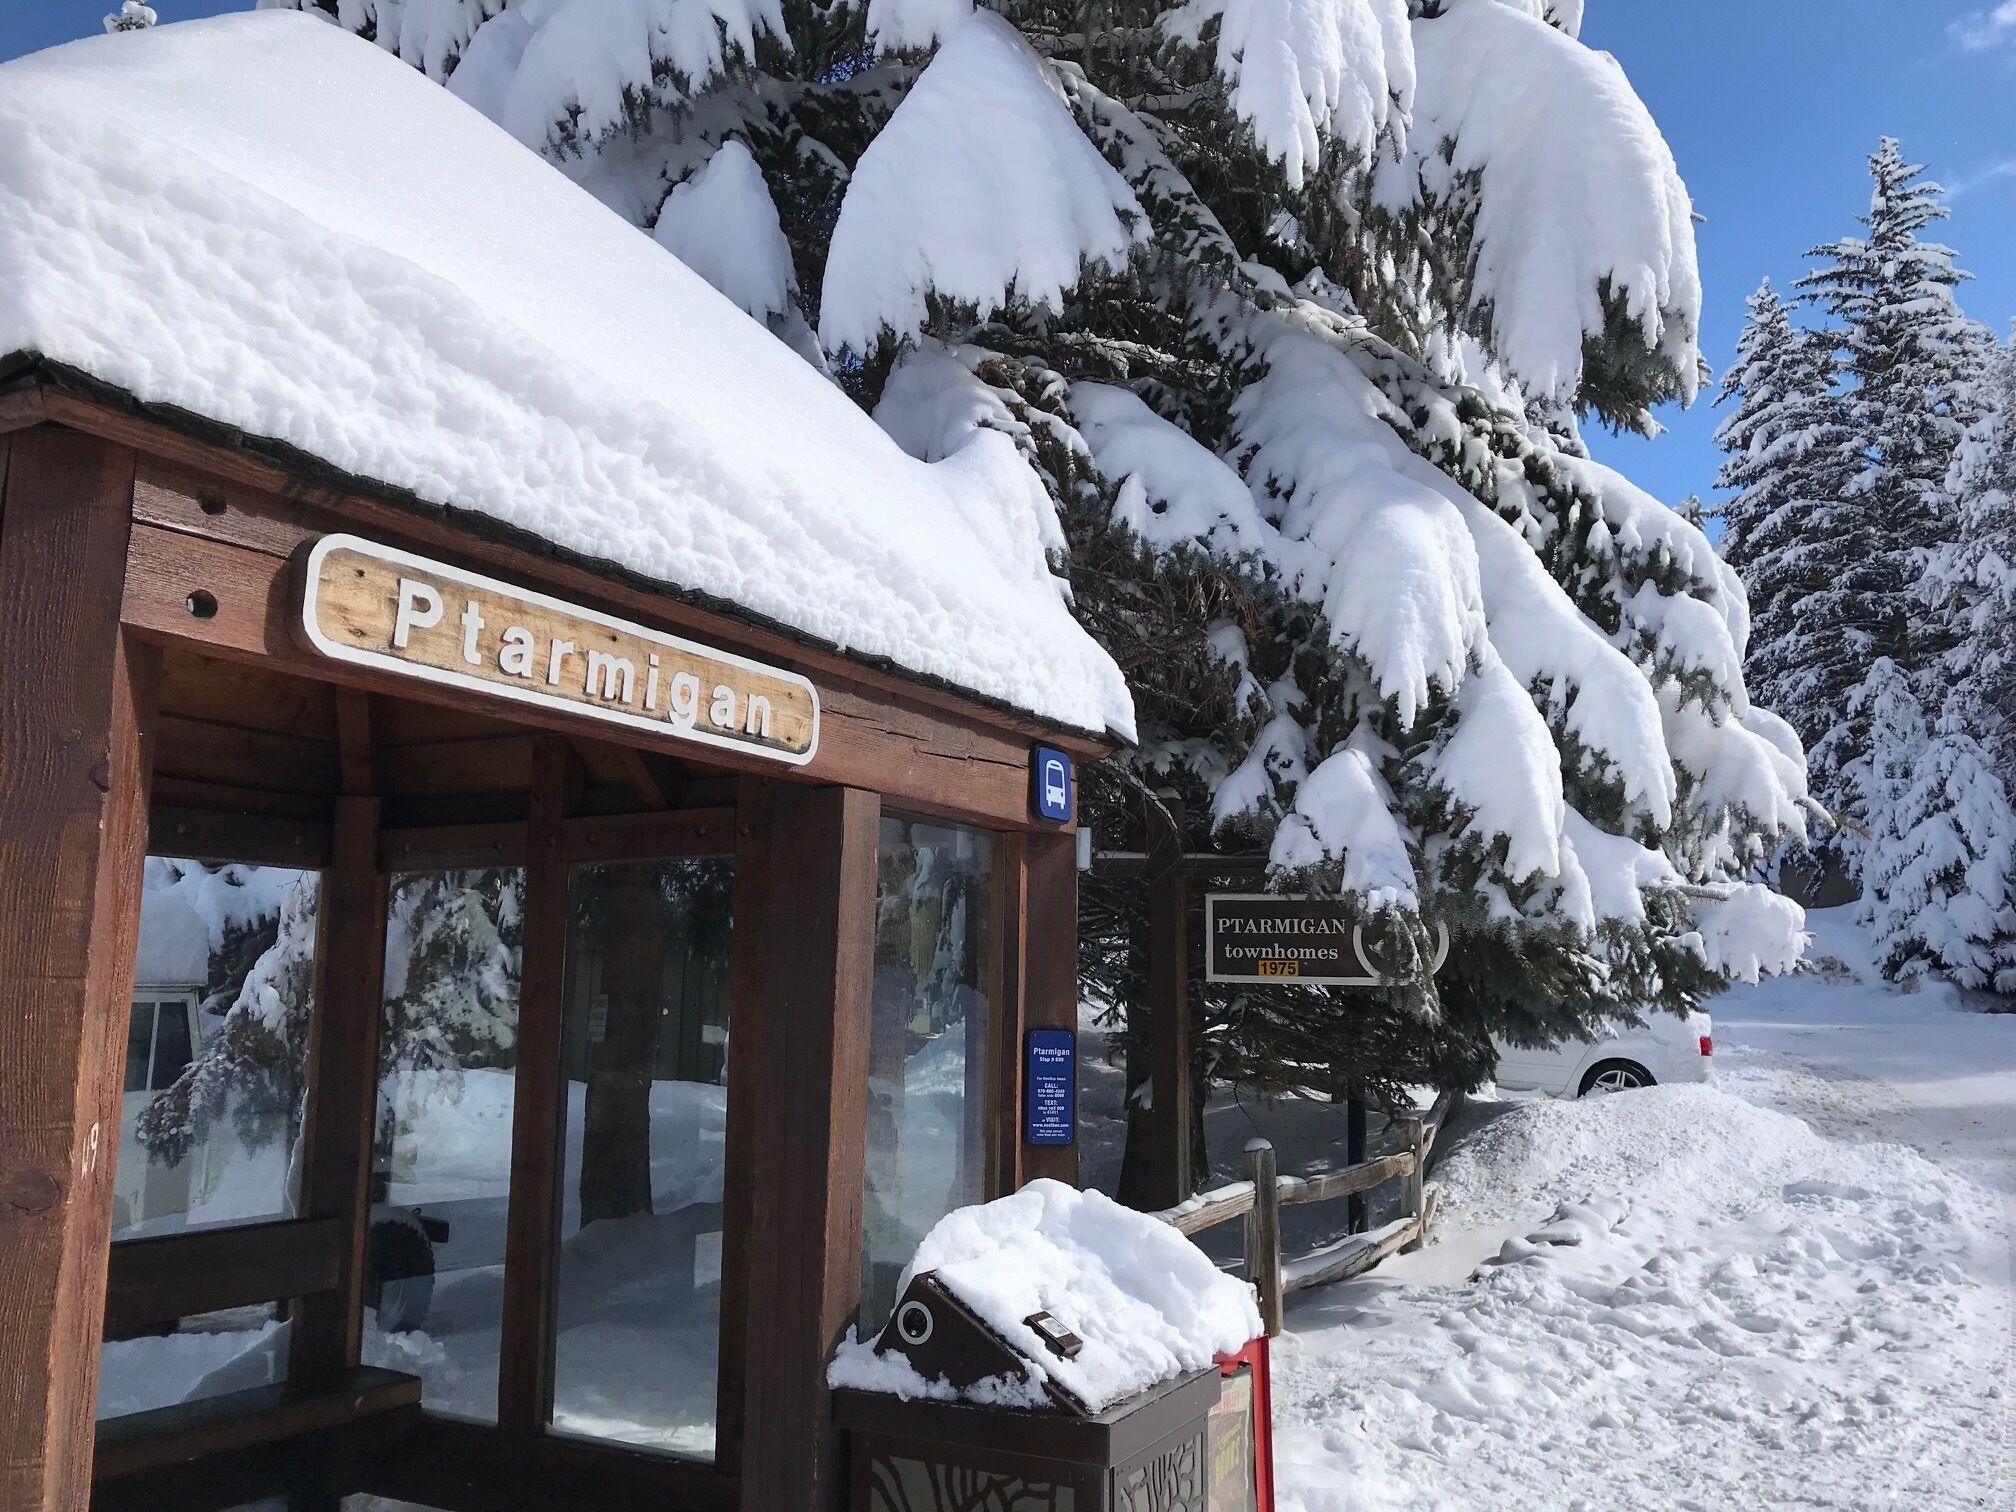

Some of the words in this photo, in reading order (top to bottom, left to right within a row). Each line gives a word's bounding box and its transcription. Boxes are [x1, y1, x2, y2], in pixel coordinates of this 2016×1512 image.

[393, 577, 771, 738] Ptarmigan
[1217, 918, 1347, 935] PTARMIGAN
[1224, 942, 1339, 960] townhomes
[1260, 961, 1297, 976] 1975
[1033, 1047, 1070, 1057] Ptarmigan
